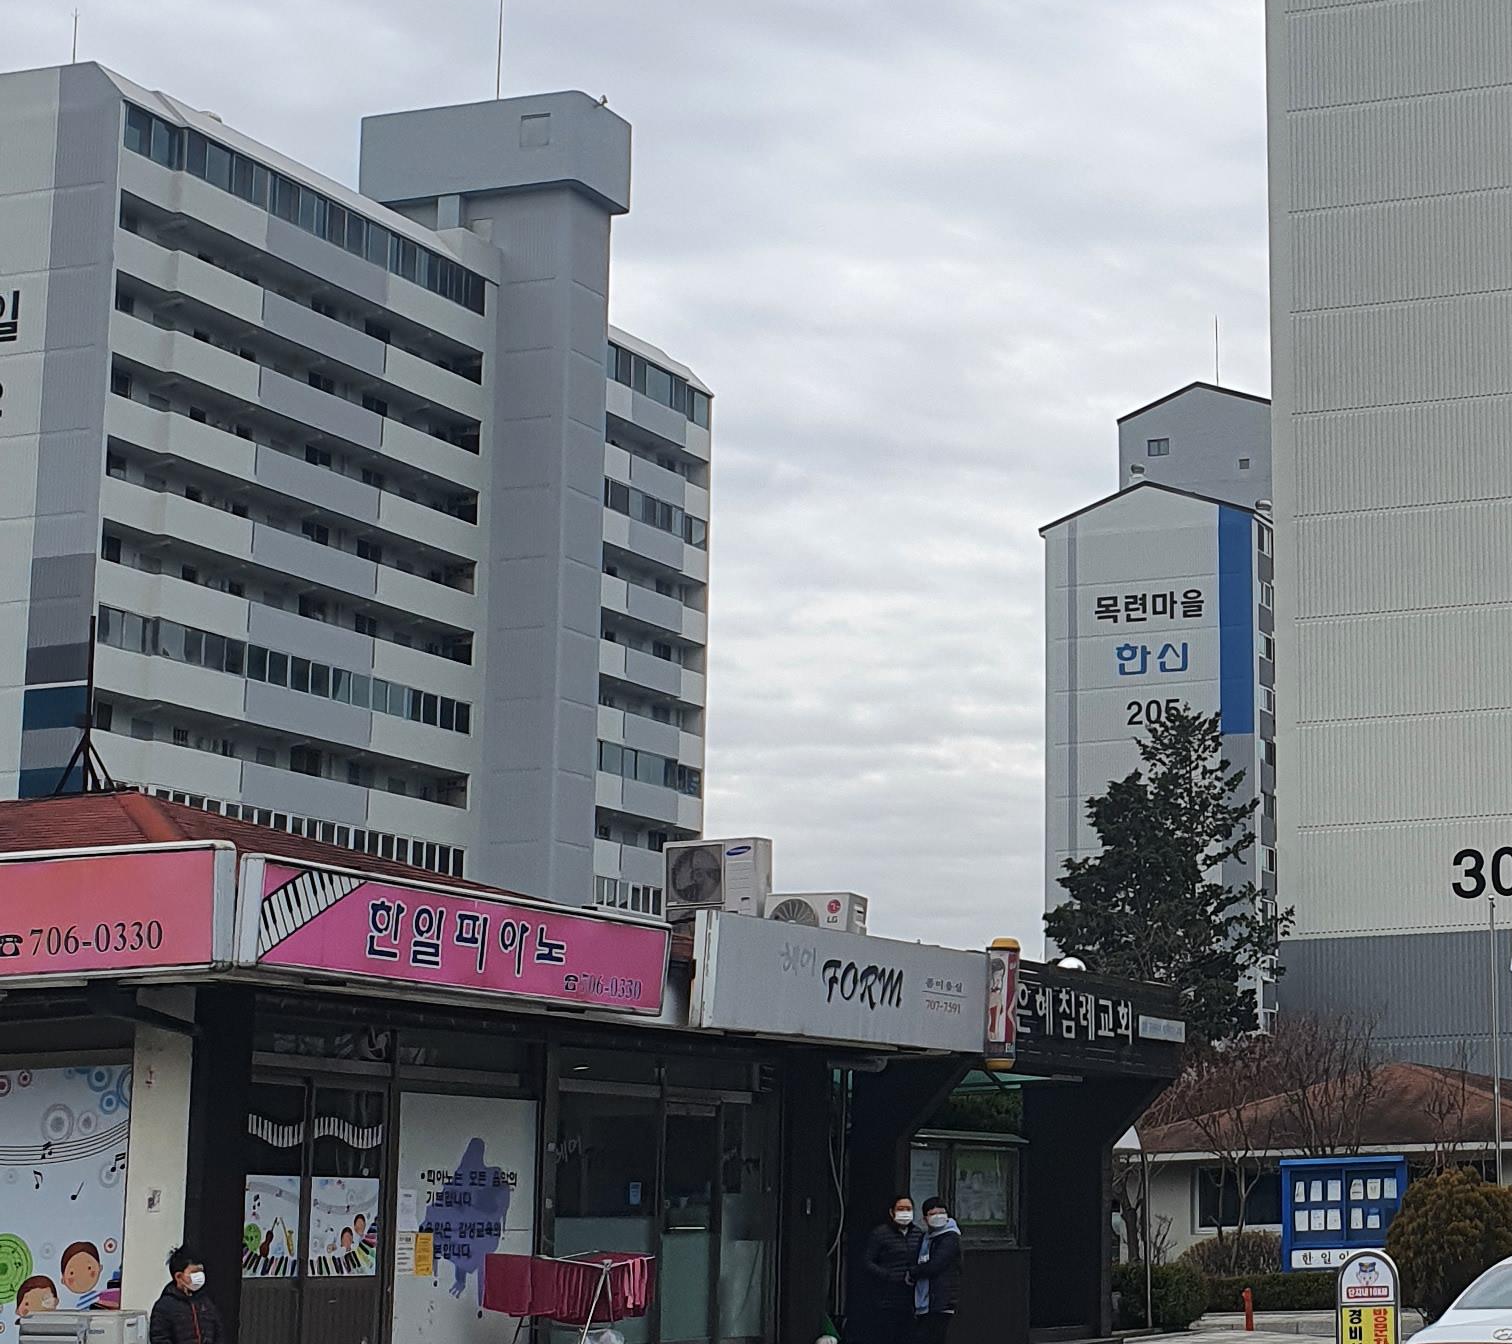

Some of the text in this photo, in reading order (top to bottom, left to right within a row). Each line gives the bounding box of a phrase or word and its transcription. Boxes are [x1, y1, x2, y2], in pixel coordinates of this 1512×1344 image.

[1094, 589, 1204, 623] 목련마을
[1116, 642, 1188, 675] 한신
[1126, 699, 1181, 726] 205
[29, 920, 163, 956] 706-0330
[366, 900, 566, 976] 한일피아노
[580, 973, 642, 1000] 706-0330
[822, 959, 904, 1011] FORM
[427, 1169, 518, 1187] 피아노는 모든 음악의
[426, 1191, 472, 1208] 기본입니다
[433, 1243, 471, 1260] 본입니다
